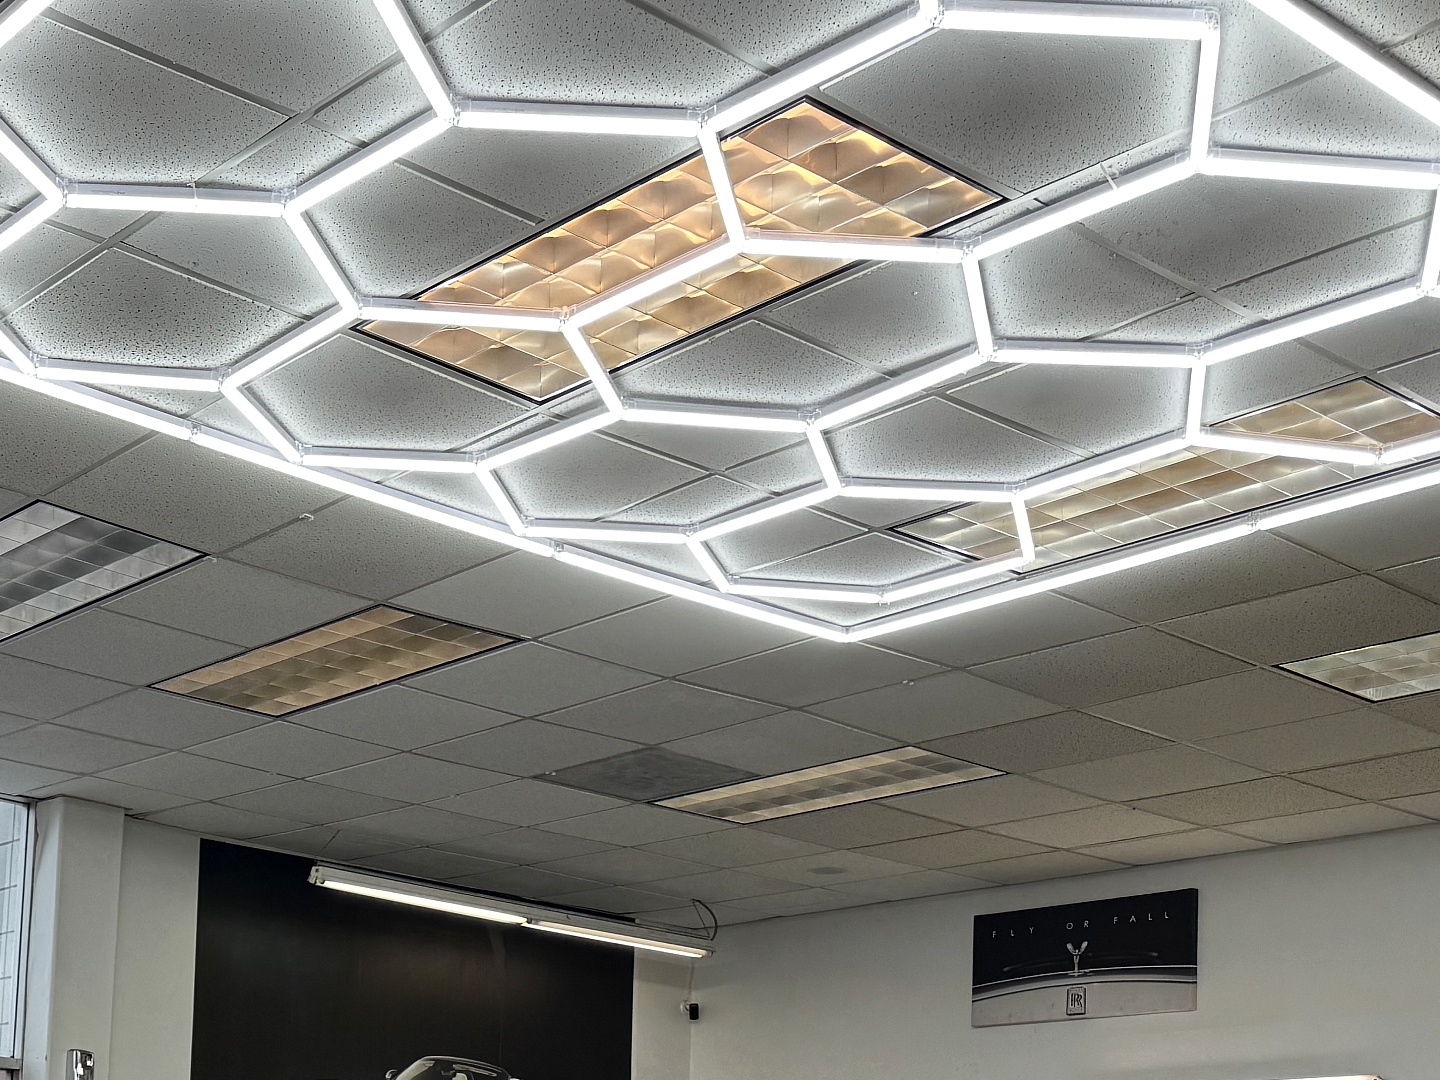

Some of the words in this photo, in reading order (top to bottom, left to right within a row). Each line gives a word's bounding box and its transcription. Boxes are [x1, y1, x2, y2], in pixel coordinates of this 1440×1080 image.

[992, 926, 1034, 938] FLY
[1066, 920, 1089, 930] OR
[1113, 912, 1169, 925] FALL
